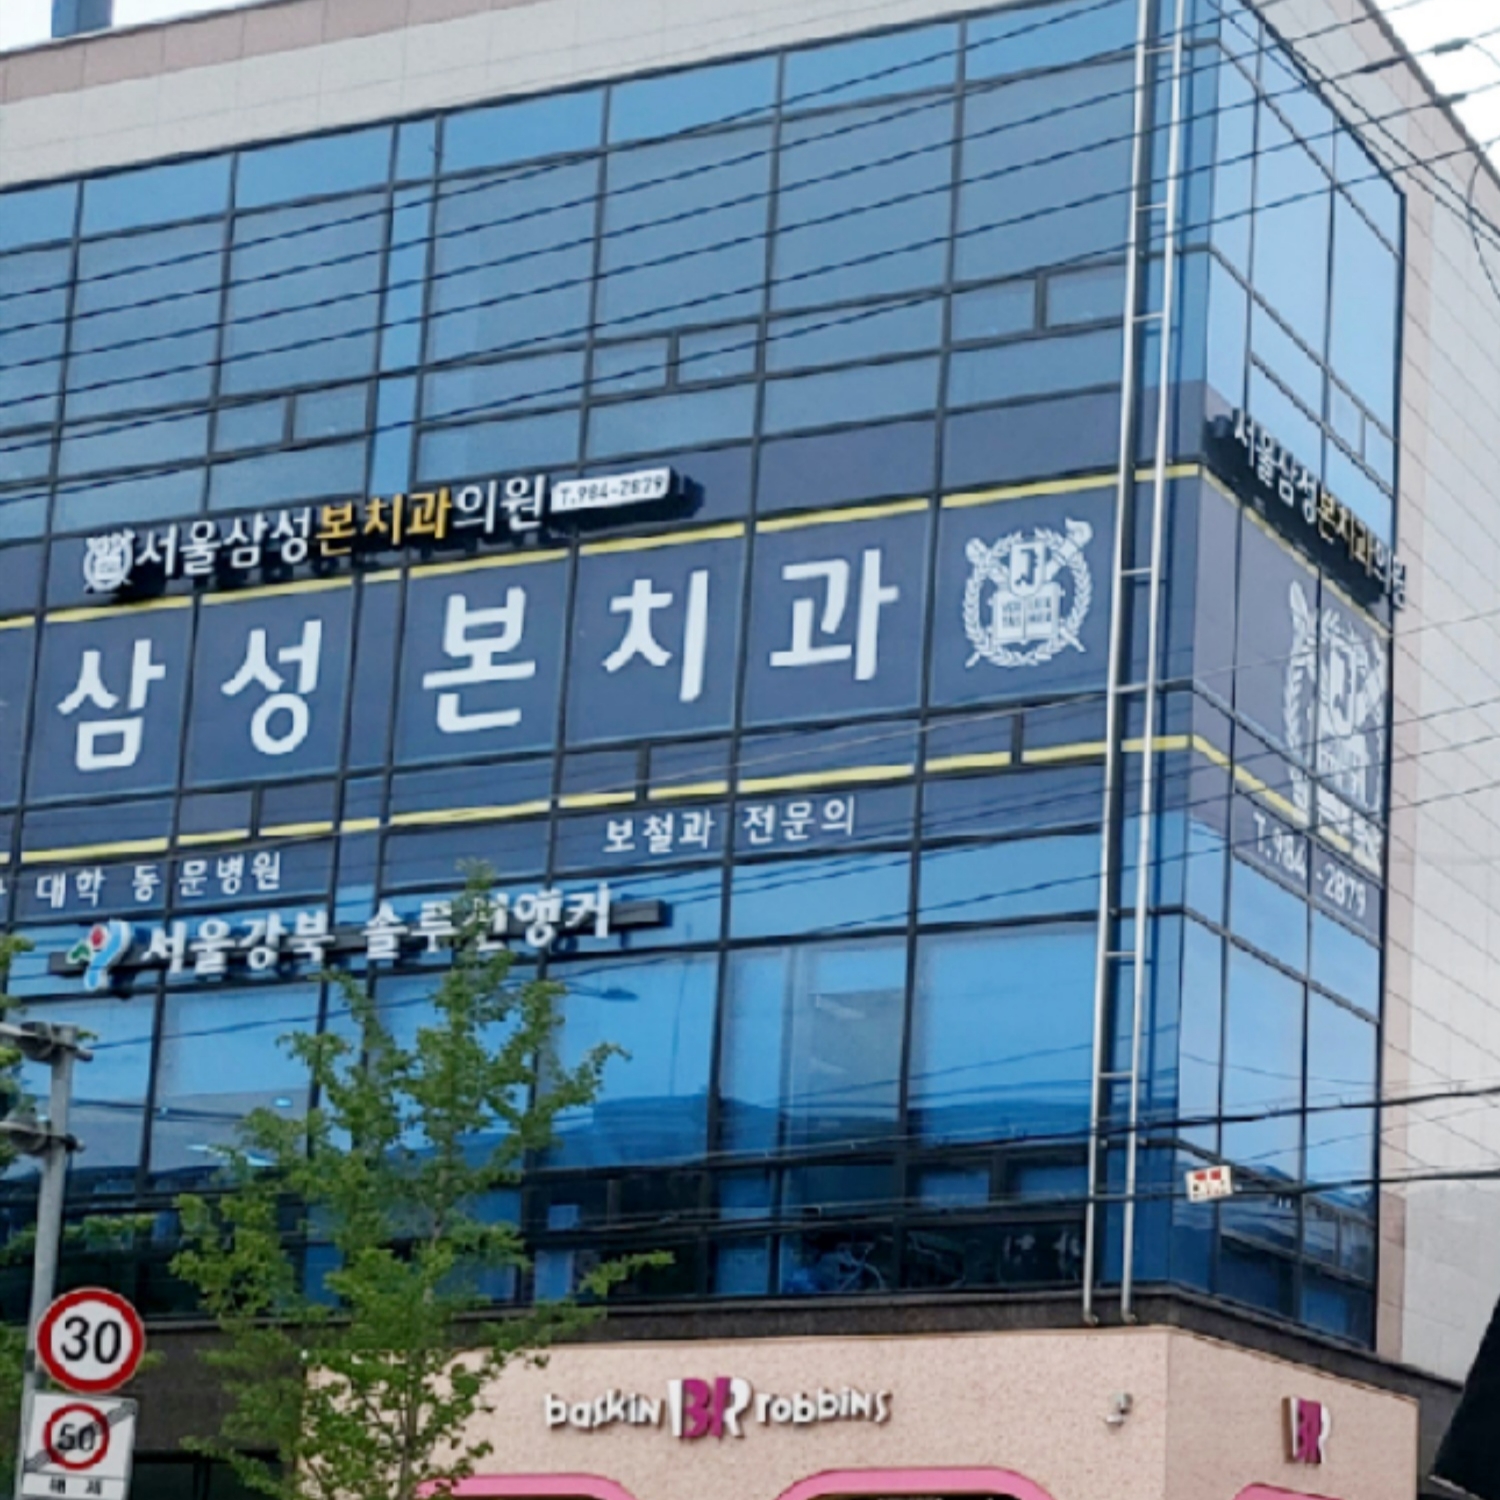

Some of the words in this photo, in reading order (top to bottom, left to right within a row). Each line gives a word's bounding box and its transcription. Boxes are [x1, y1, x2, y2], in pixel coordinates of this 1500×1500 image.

[135, 474, 546, 577] 서울삼성본치과의원
[602, 809, 716, 854] 보철과
[742, 795, 854, 844] 전문의
[36, 866, 106, 909] 대학
[140, 910, 335, 975] 서울강북
[61, 1315, 121, 1364] 30
[545, 1389, 660, 1428] baskin
[756, 1387, 892, 1424] robbins
[58, 1423, 96, 1451] 50
